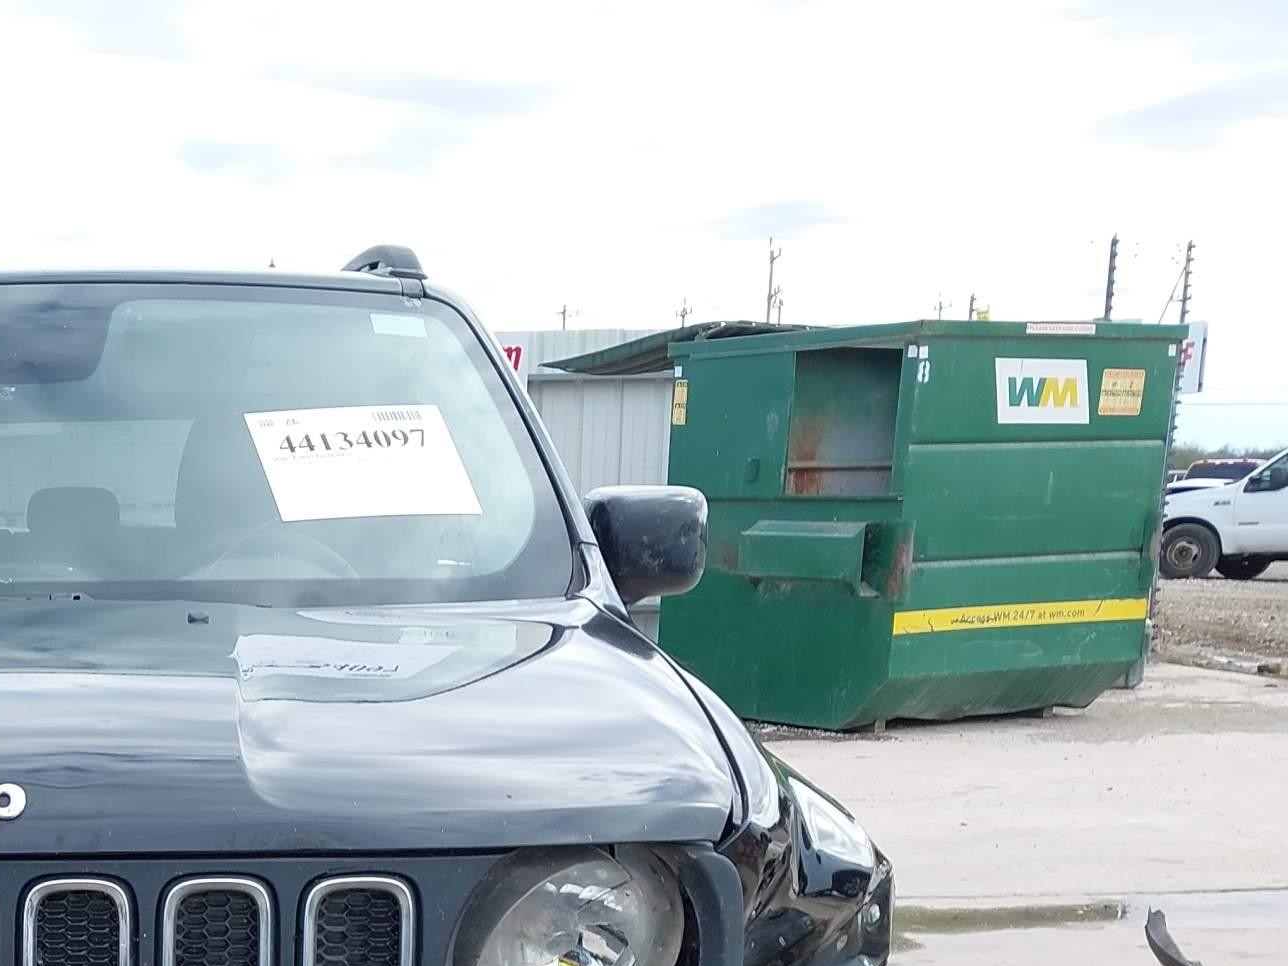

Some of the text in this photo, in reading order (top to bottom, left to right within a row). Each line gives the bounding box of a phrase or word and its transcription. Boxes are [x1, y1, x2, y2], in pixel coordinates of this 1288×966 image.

[1008, 376, 1079, 408] WM
[279, 429, 425, 453] 44134097
[1013, 609, 1036, 621] 24/7
[1038, 610, 1046, 620] at
[1049, 608, 1085, 619] wm.com
